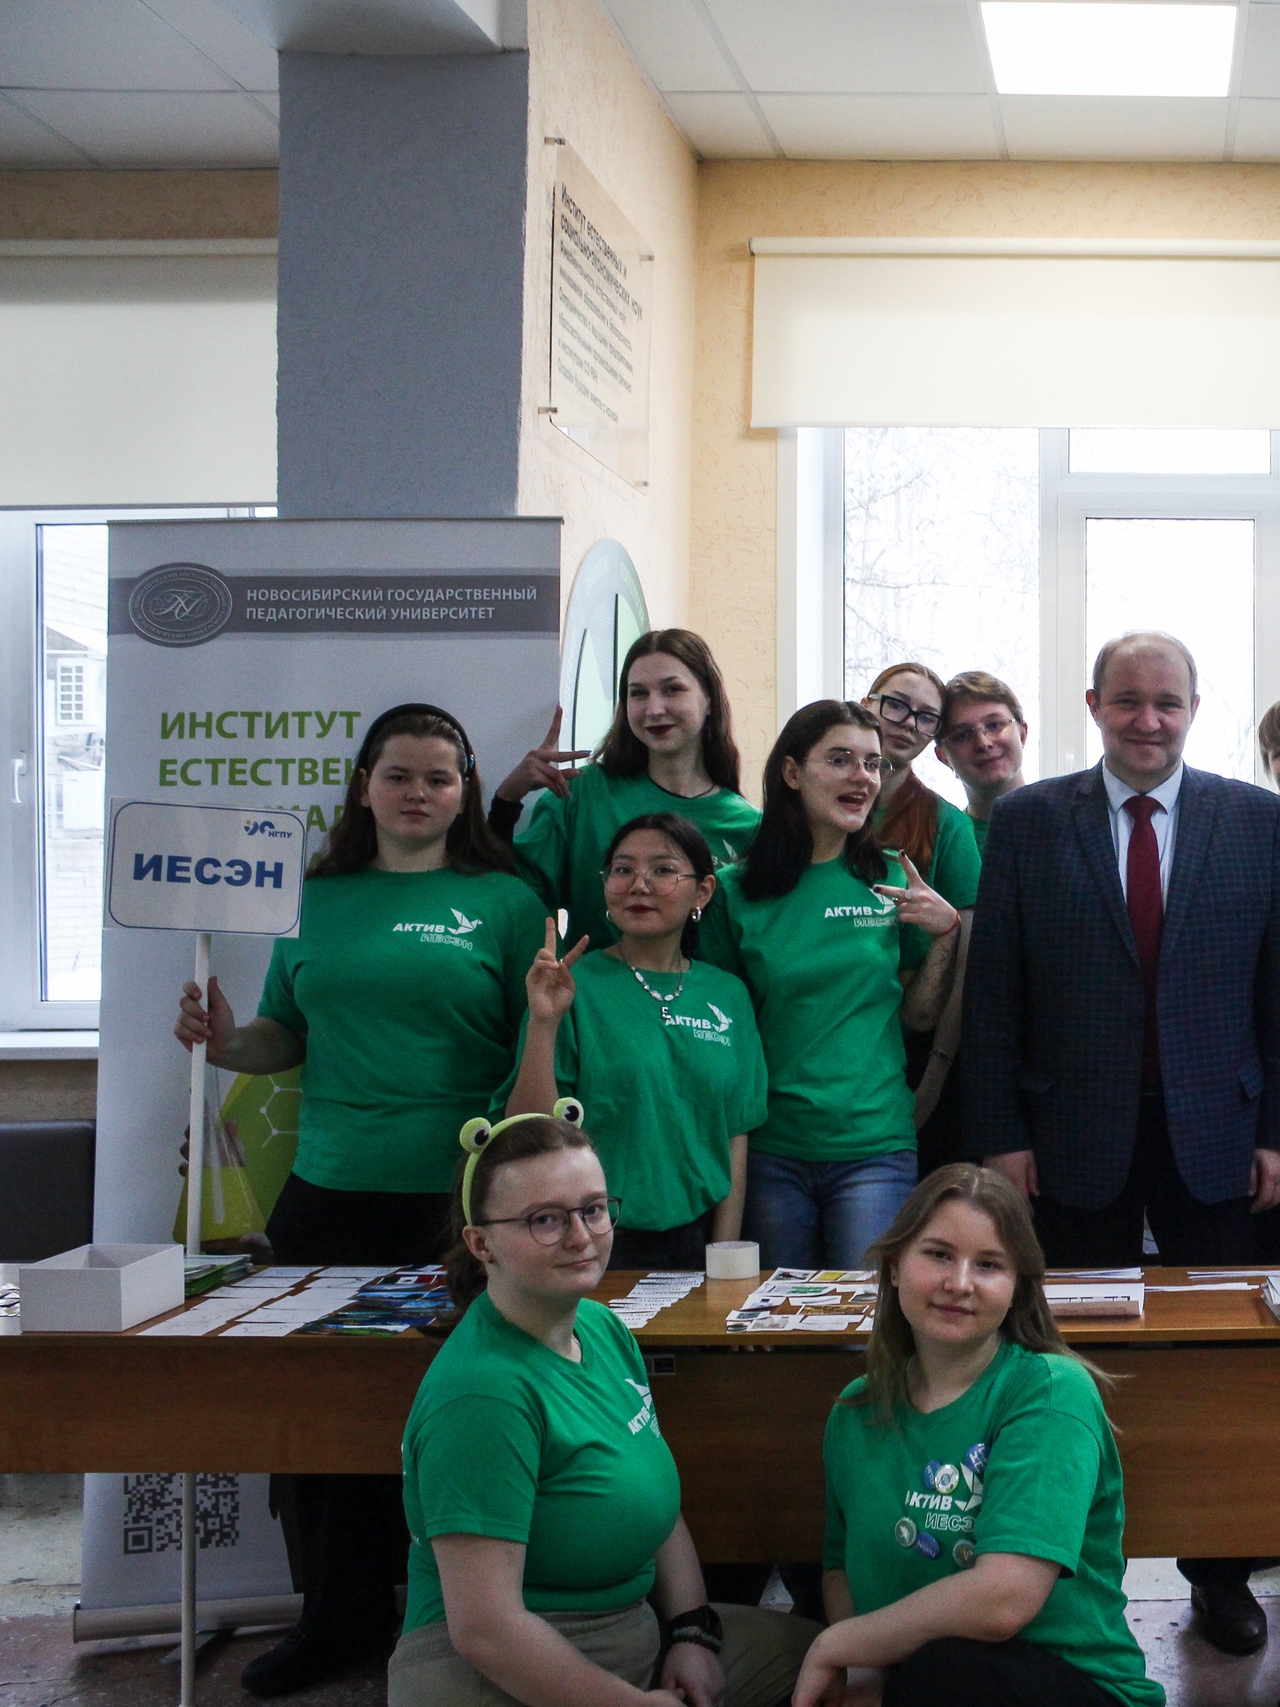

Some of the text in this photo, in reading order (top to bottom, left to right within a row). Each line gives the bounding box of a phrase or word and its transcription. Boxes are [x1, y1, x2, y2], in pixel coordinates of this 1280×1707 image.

[561, 179, 586, 237] Институт
[586, 217, 622, 276] естественных
[246, 584, 538, 602] НОВОСИБИРСКИЙ ГОСУДАРСТВЕННЫЙ
[246, 604, 495, 622] ПЕДАГОГИЧЕСКИЙ УНИВЕРСИТЕТ
[160, 711, 361, 739] ИНСТИТУТ
[268, 830, 293, 839] НГПУ
[133, 853, 284, 889] ИЕСЭН
[824, 906, 873, 918] АКТИВ
[392, 922, 446, 933] АКТИВ
[420, 933, 474, 951] ИЕСЭН
[665, 1015, 712, 1029] АКТИВ
